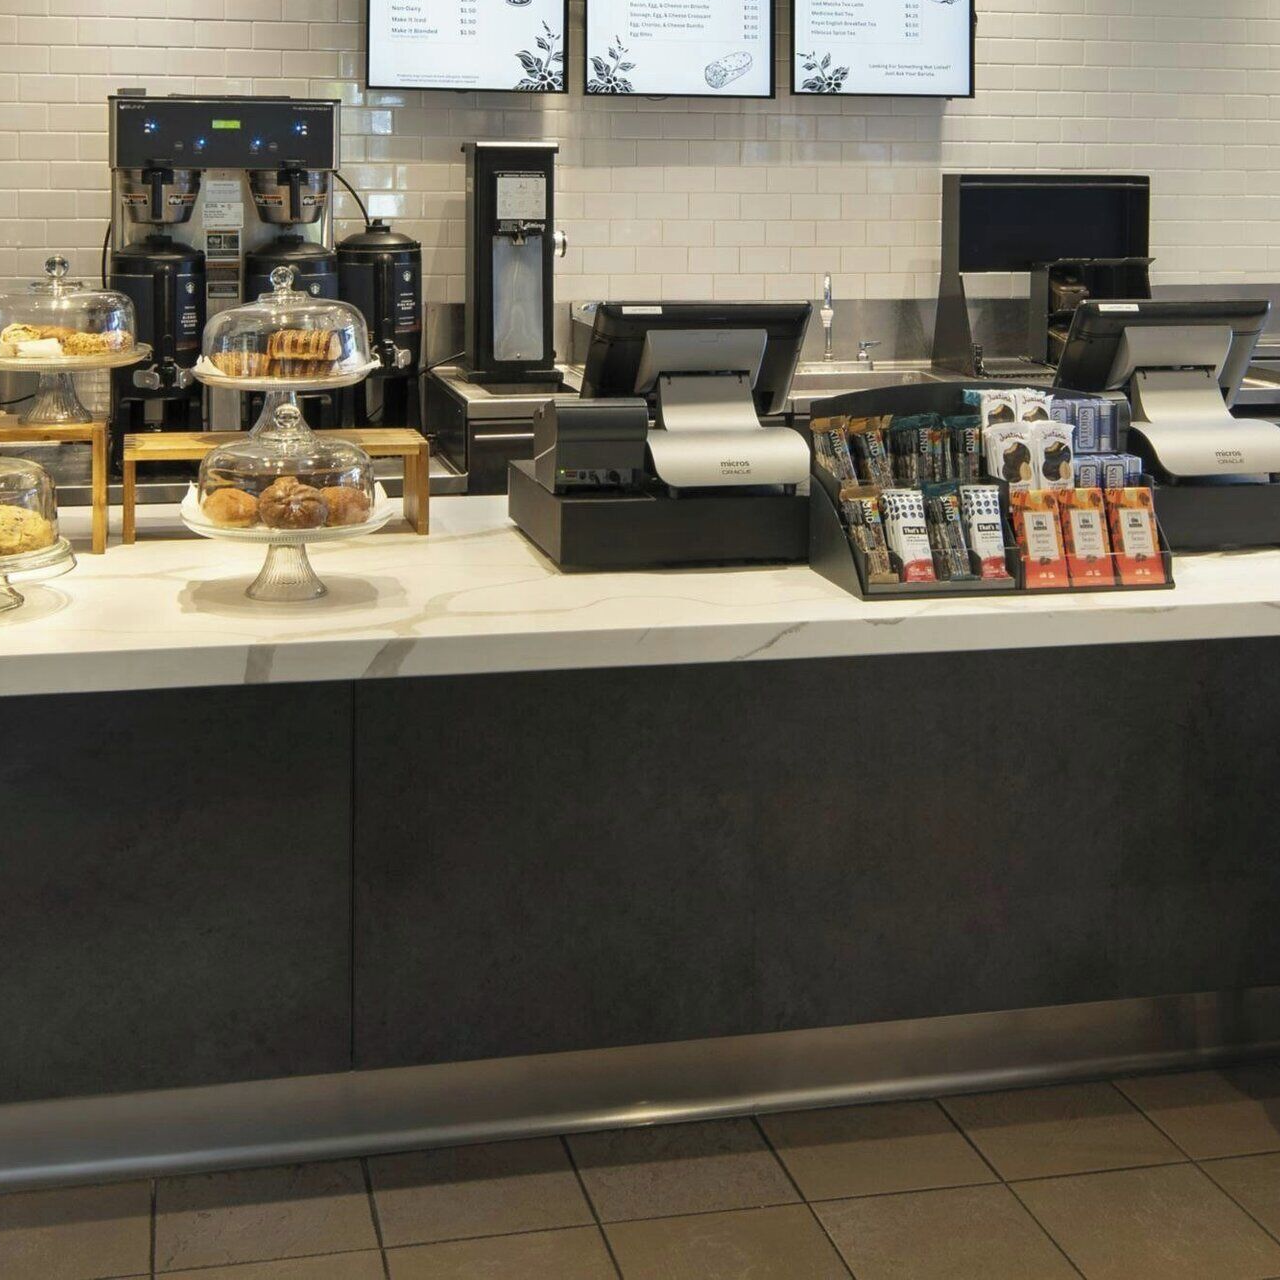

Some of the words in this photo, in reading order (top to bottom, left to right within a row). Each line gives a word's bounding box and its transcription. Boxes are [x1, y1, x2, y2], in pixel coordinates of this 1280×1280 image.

[919, 428, 929, 453] KIND
[965, 427, 975, 453] KIND
[1080, 410, 1090, 446] ALTOIDS
[829, 429, 843, 454] KIND
[720, 459, 750, 468] micros
[862, 500, 874, 523] KIND
[940, 495, 955, 522] KIND
